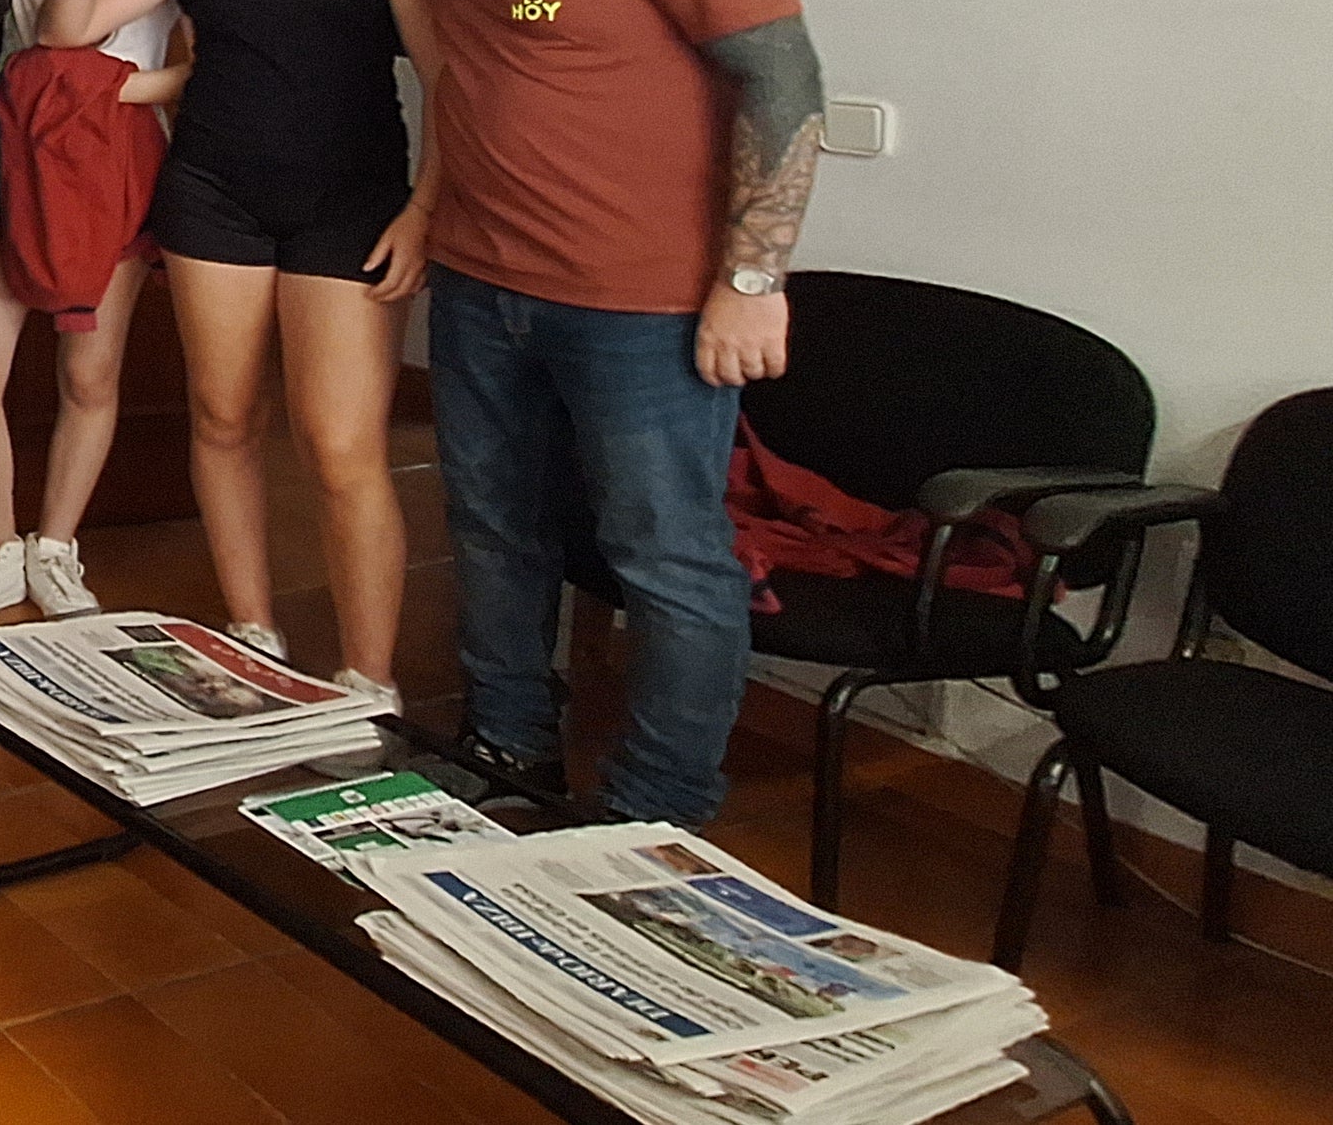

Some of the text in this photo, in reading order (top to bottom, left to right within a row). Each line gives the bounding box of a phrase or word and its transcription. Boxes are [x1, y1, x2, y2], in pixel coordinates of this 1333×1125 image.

[512, 1, 562, 22] HOY
[463, 891, 535, 939] IBIZA
[558, 958, 671, 1021] DIARIO
